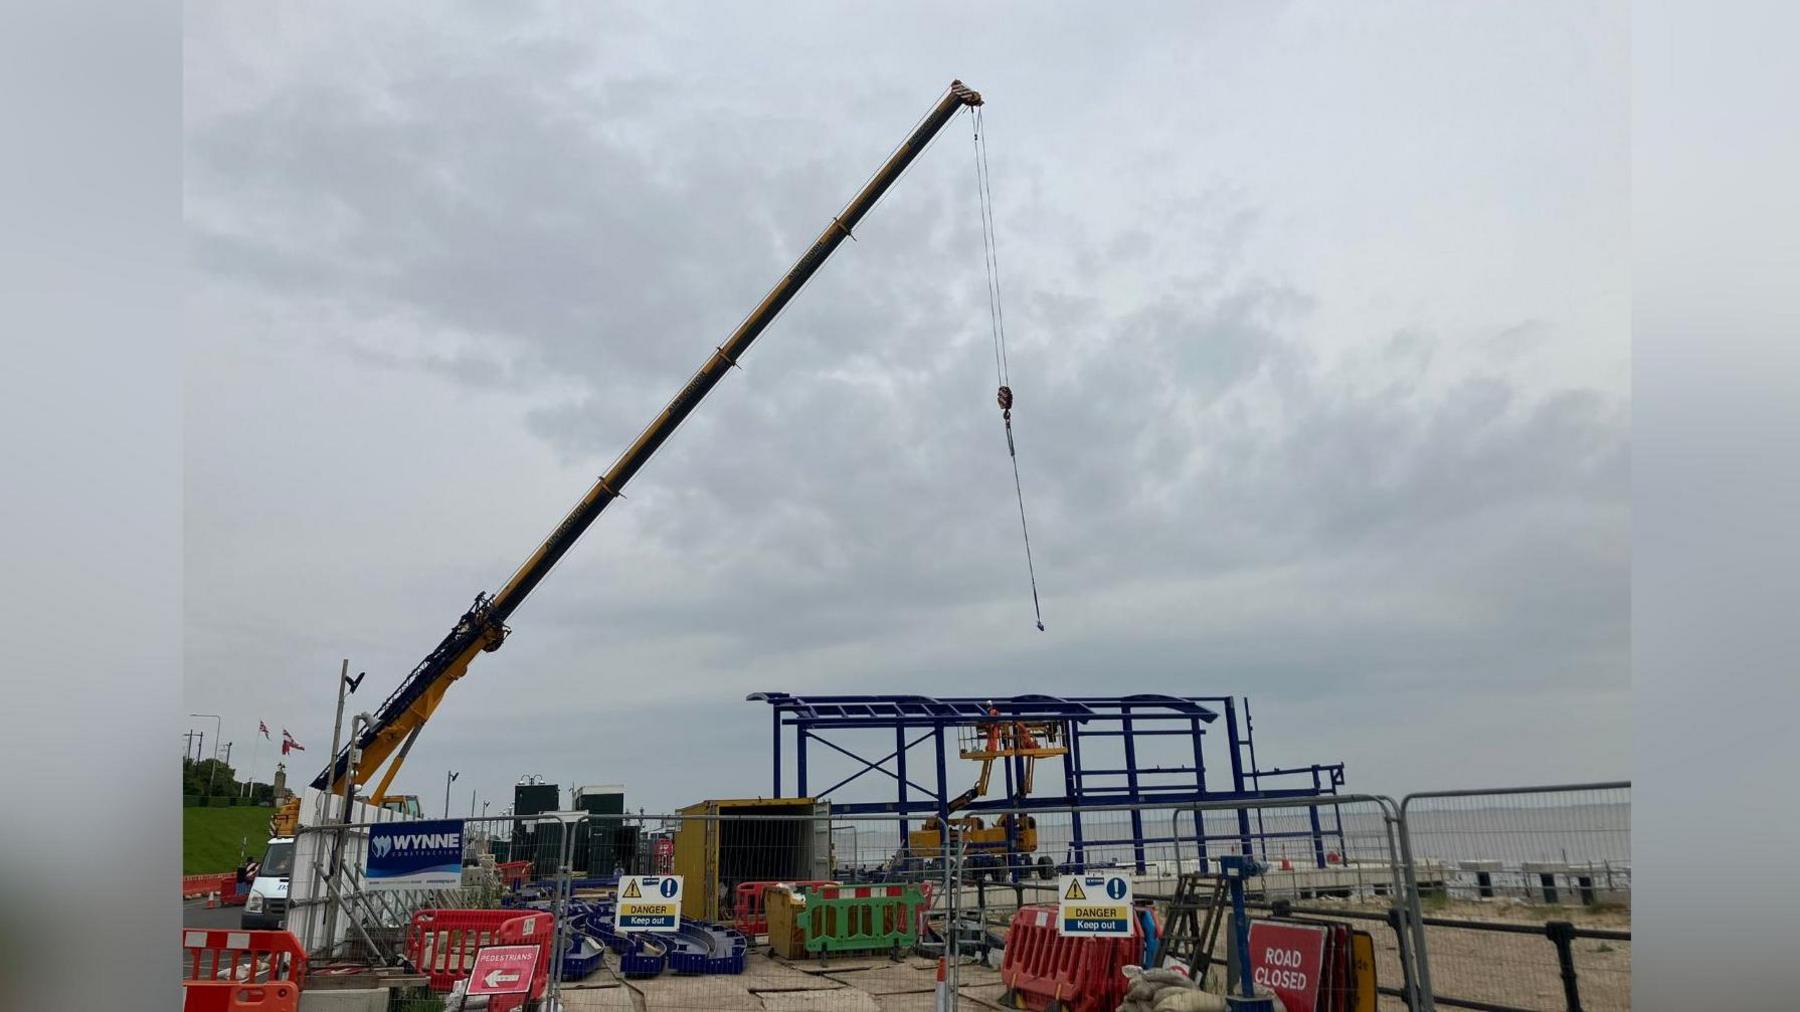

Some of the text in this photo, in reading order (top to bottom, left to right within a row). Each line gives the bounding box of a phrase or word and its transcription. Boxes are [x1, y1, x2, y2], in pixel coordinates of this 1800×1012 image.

[393, 833, 460, 850] WYNNE
[630, 906, 667, 914] DANGER
[1075, 908, 1117, 918] DANGER
[631, 916, 650, 926] Keep
[1077, 920, 1116, 930] Keep out
[480, 953, 533, 962] PEDESTRIANS
[1265, 948, 1302, 968] ROAD
[1255, 967, 1307, 990] CLOSED
